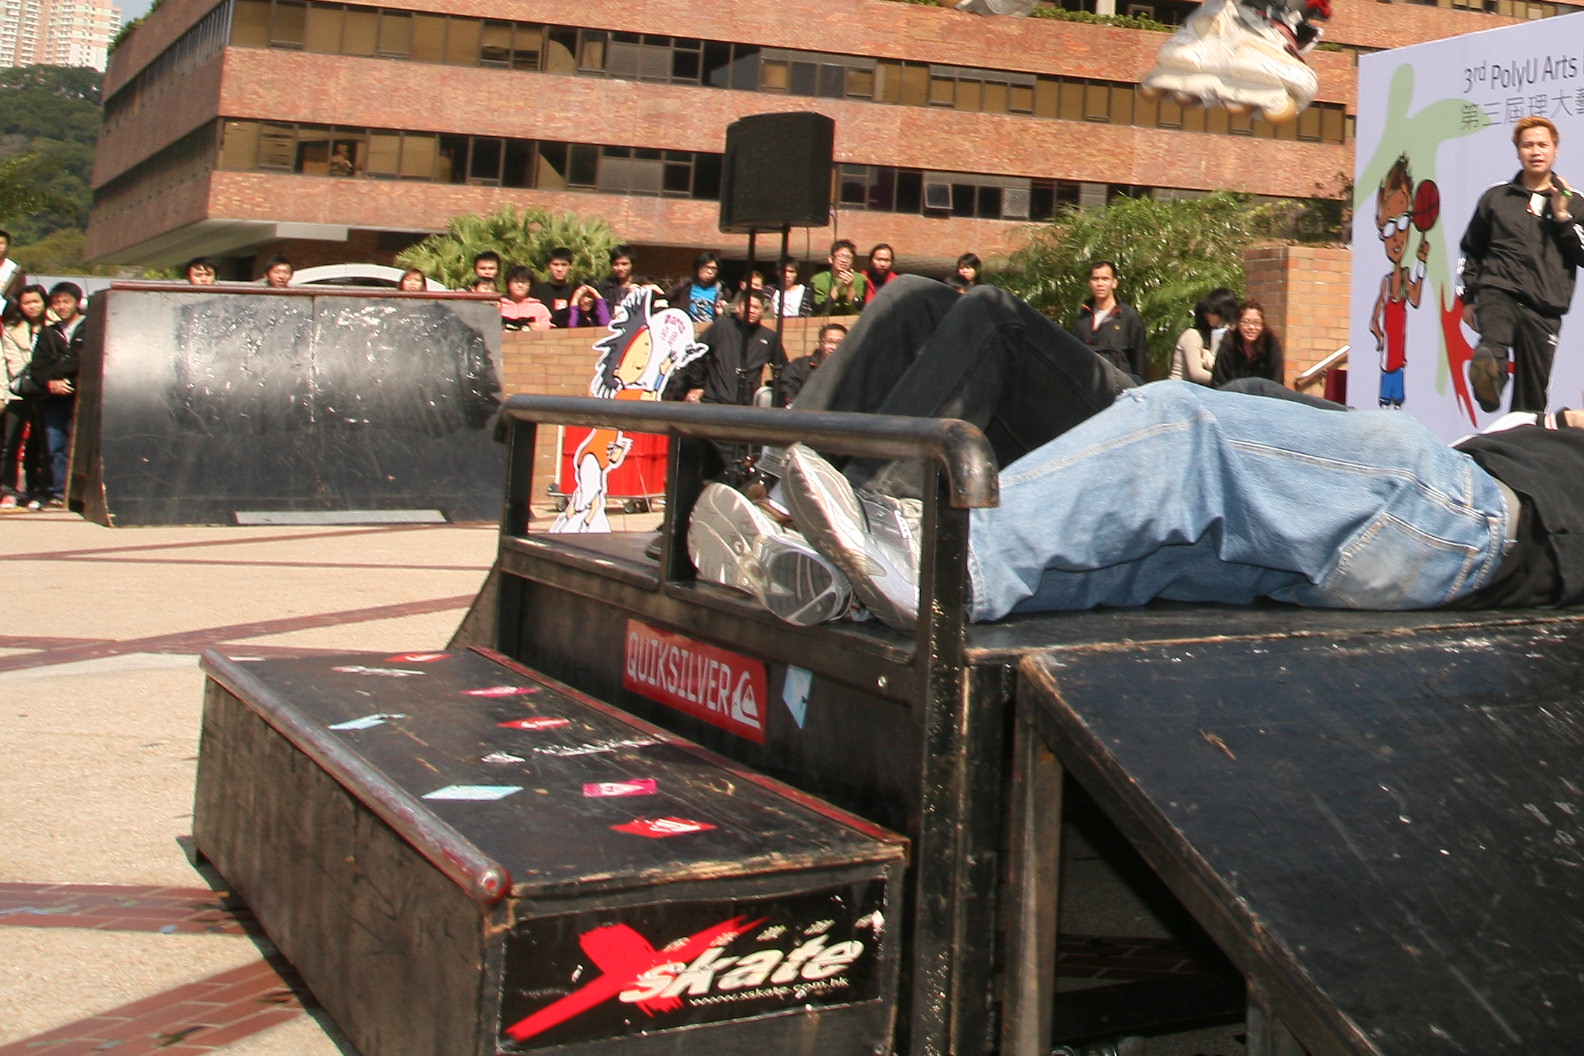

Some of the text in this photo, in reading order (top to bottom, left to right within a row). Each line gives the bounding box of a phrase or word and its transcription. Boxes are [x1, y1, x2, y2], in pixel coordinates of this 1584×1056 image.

[1463, 59, 1488, 93] 3rd
[1490, 57, 1538, 93] PolyU
[1542, 54, 1577, 82] Arts
[626, 630, 734, 717] QUIKSILVER
